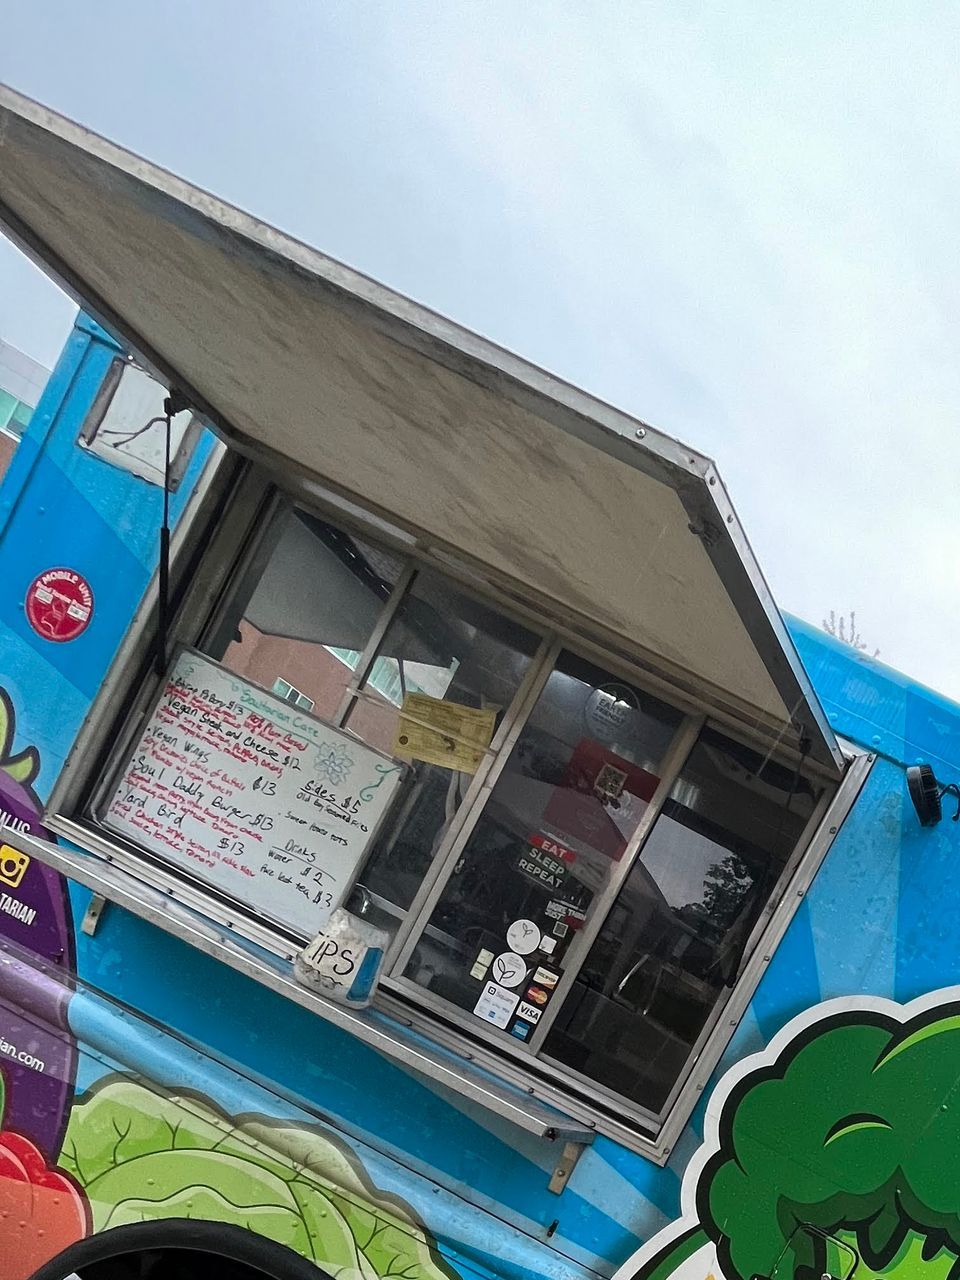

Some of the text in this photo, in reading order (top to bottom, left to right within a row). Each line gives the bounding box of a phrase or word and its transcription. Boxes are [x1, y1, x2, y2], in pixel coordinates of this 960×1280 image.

[149, 726, 277, 796] Vegan Wings $13
[243, 737, 279, 762] Cheese
[133, 756, 165, 780] Soul
[172, 775, 205, 803] Daddy
[211, 795, 252, 821] Burger
[305, 780, 336, 803] Sides
[122, 785, 245, 856] Yard Bird $13
[529, 847, 564, 875] SLEEP
[541, 840, 566, 857] EAT
[518, 858, 562, 887] REPEAT
[520, 1005, 538, 1020] VISA
